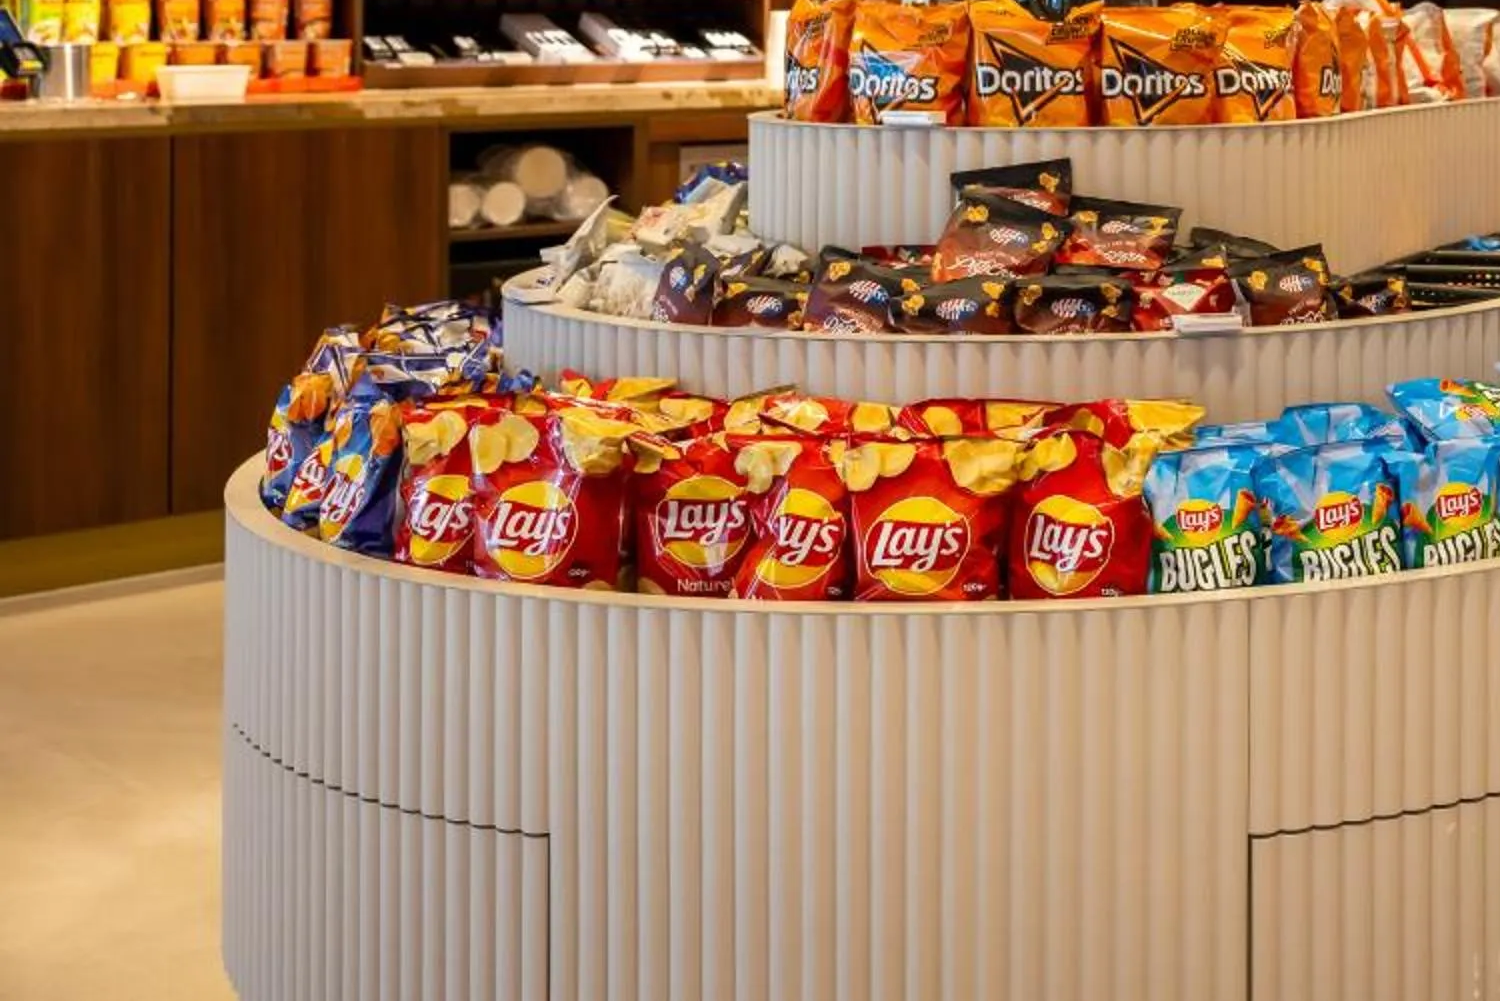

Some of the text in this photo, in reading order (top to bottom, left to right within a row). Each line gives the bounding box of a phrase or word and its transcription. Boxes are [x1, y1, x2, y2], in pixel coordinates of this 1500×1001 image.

[851, 68, 936, 100] Doritos
[977, 65, 1085, 94] Doritos
[1102, 68, 1205, 97] Doritos
[1181, 505, 1222, 532] Lay's
[1319, 499, 1362, 531] Lay's
[1440, 489, 1481, 518] Lay's
[485, 501, 572, 557] Lay's
[664, 494, 746, 546] Lay's
[871, 520, 964, 573] Lay's
[1029, 514, 1109, 572] Lay's
[1159, 529, 1257, 592] BUGLES
